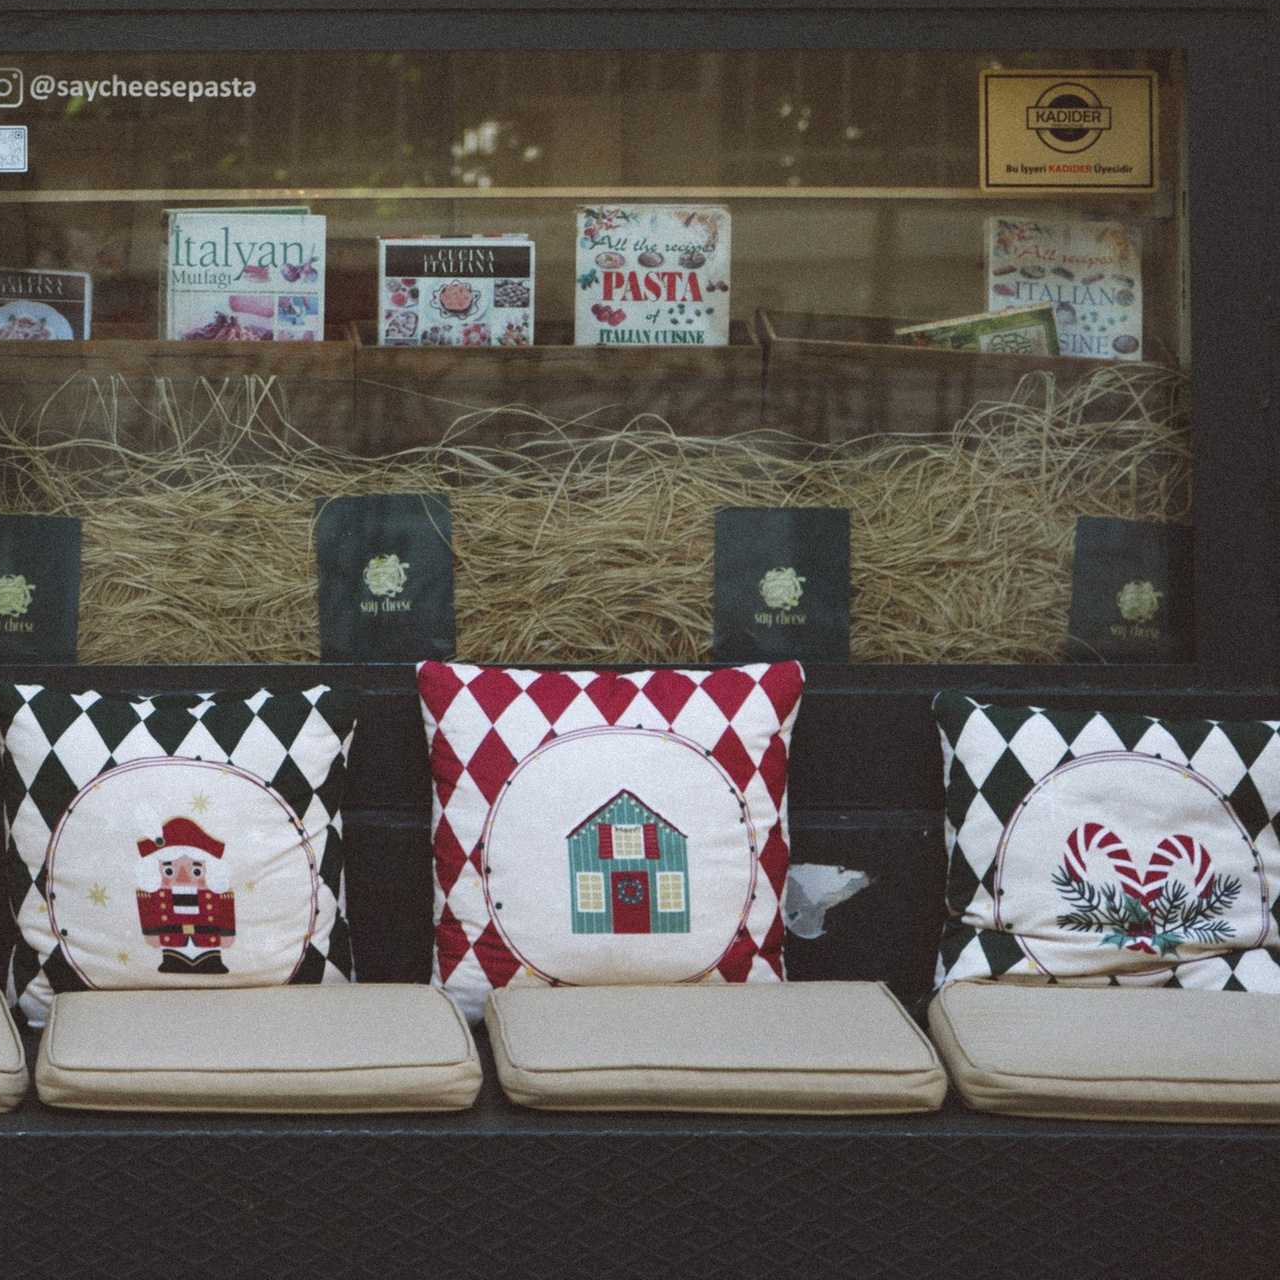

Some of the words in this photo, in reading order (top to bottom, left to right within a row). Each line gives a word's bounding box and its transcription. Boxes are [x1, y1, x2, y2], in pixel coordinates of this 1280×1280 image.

[30, 74, 257, 103] @saycheesepasta
[1036, 109, 1102, 123] KADIDER
[1006, 164, 1019, 173] Bu
[172, 225, 304, 282] İtalyan
[437, 248, 495, 262] CUCINA
[590, 235, 627, 252] All
[632, 238, 657, 253] the
[664, 241, 716, 258] recipes
[1017, 244, 1057, 261] All
[423, 260, 495, 274] ITALIANA
[601, 270, 704, 303] PASTA
[1015, 280, 1117, 307] ITALIAN
[645, 308, 661, 325] of
[599, 328, 651, 345] ITALIAN
[655, 329, 706, 345] CUISINE
[1059, 332, 1110, 356] SINE
